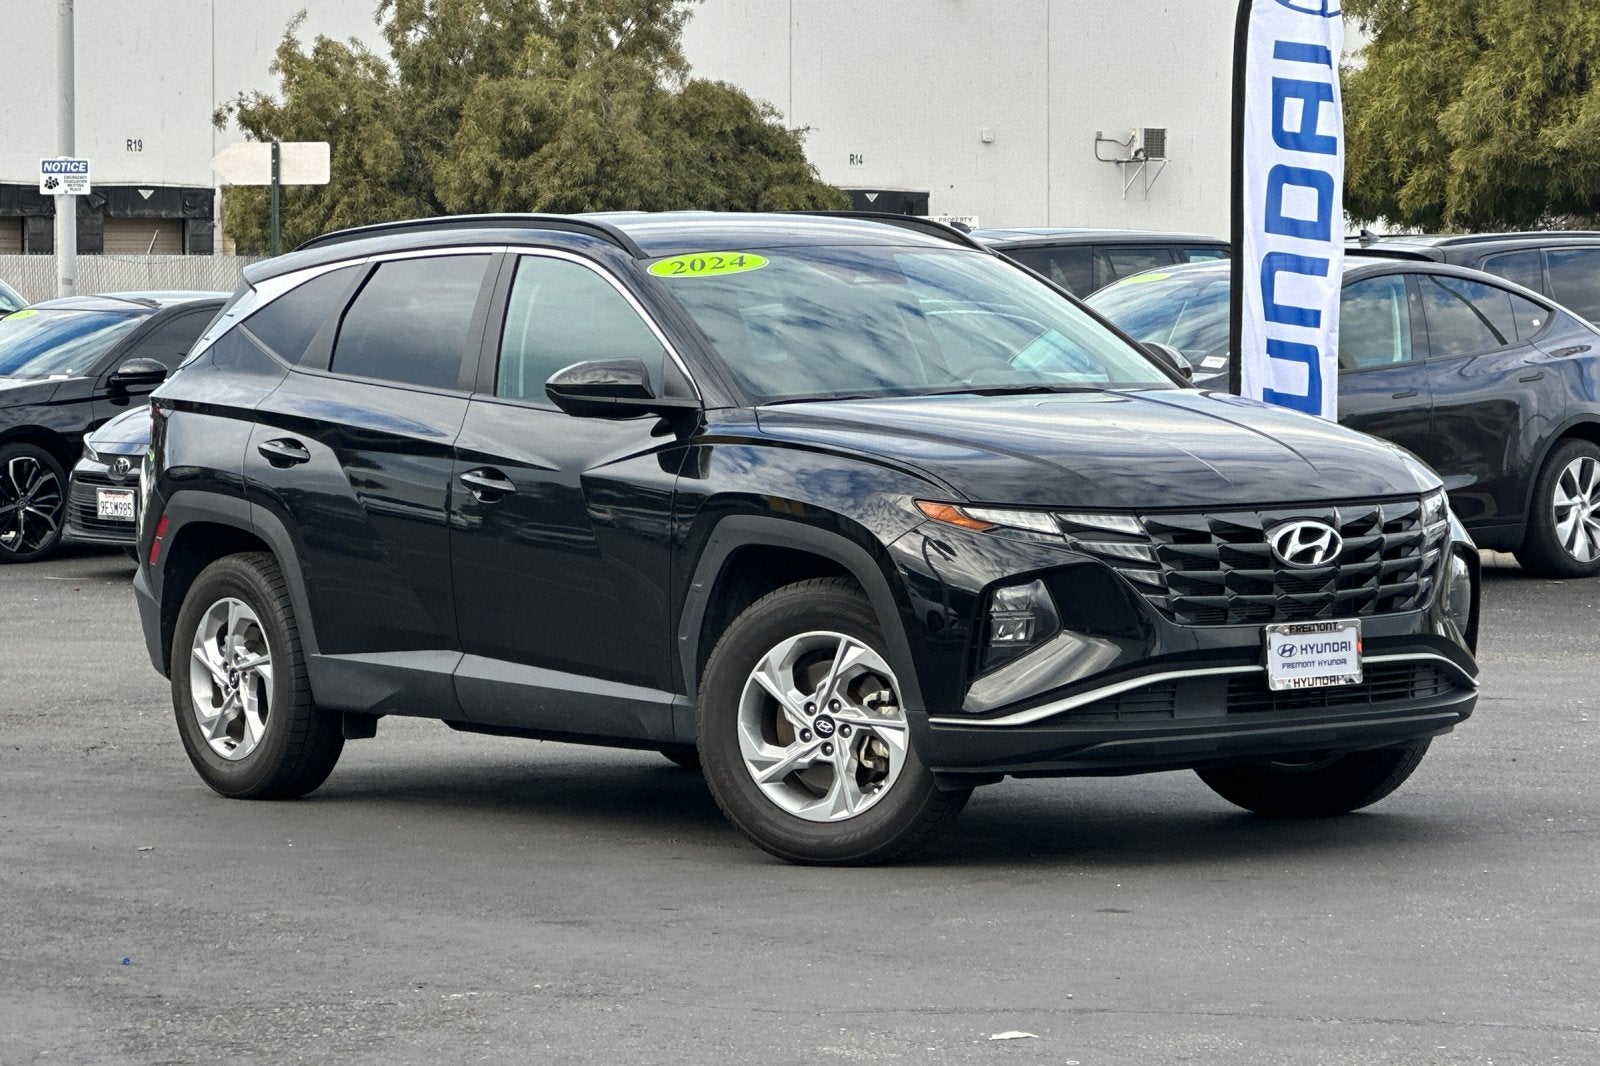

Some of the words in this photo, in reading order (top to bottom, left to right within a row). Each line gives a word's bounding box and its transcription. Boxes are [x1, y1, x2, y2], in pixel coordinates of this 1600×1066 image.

[126, 139, 142, 152] R19
[849, 153, 863, 166] R14
[44, 162, 86, 172] NOTICE
[669, 254, 747, 275] 2024
[1289, 621, 1339, 634] FREMONT
[1300, 640, 1352, 655] HYUNDAI
[1281, 660, 1316, 670] FREMONT
[1317, 658, 1348, 668] HYUNDAI
[1293, 674, 1341, 688] HYUNDAI
